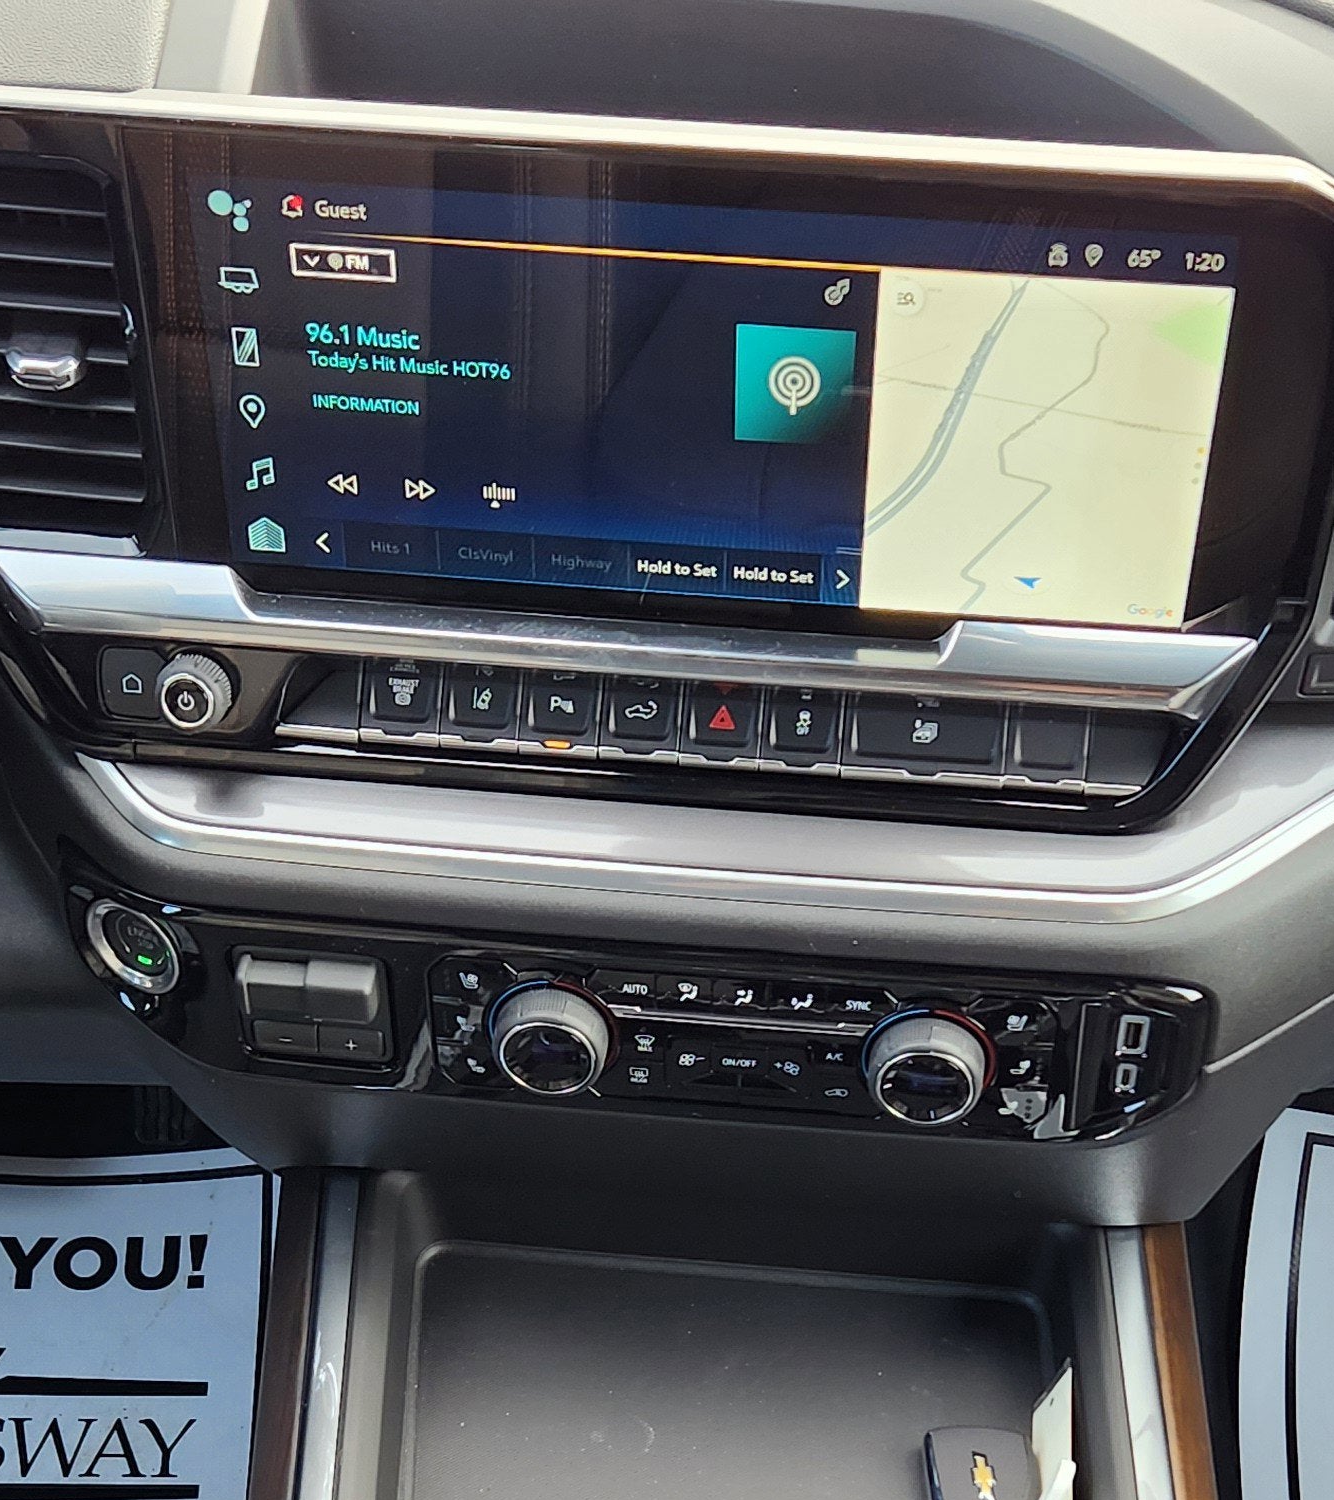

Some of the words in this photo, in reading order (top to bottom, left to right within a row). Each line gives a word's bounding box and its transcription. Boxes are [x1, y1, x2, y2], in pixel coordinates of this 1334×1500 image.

[314, 199, 368, 222] Guest
[344, 254, 371, 272] FM
[1184, 251, 1226, 273] 1:20
[304, 322, 350, 346] 96.1
[355, 325, 421, 351] Music
[306, 350, 369, 375] Today's
[371, 354, 397, 373] Hit
[399, 357, 449, 377] Music
[452, 360, 513, 381] HOT96
[311, 393, 421, 417] INFORMATION
[370, 540, 400, 555] Hits
[403, 542, 411, 556] 1
[550, 553, 613, 572] Highway
[637, 559, 672, 575] Hold
[674, 563, 691, 576] to
[693, 562, 718, 578] Set
[733, 566, 769, 581] Hold
[770, 569, 788, 583] to
[789, 570, 815, 585] Set
[1127, 603, 1173, 619] Google
[621, 983, 648, 996] AUTO
[844, 999, 873, 1012] SYNC
[721, 1057, 758, 1069] ON/OFF
[825, 1052, 844, 1062] A/C
[1, 1233, 209, 1291] YOU!
